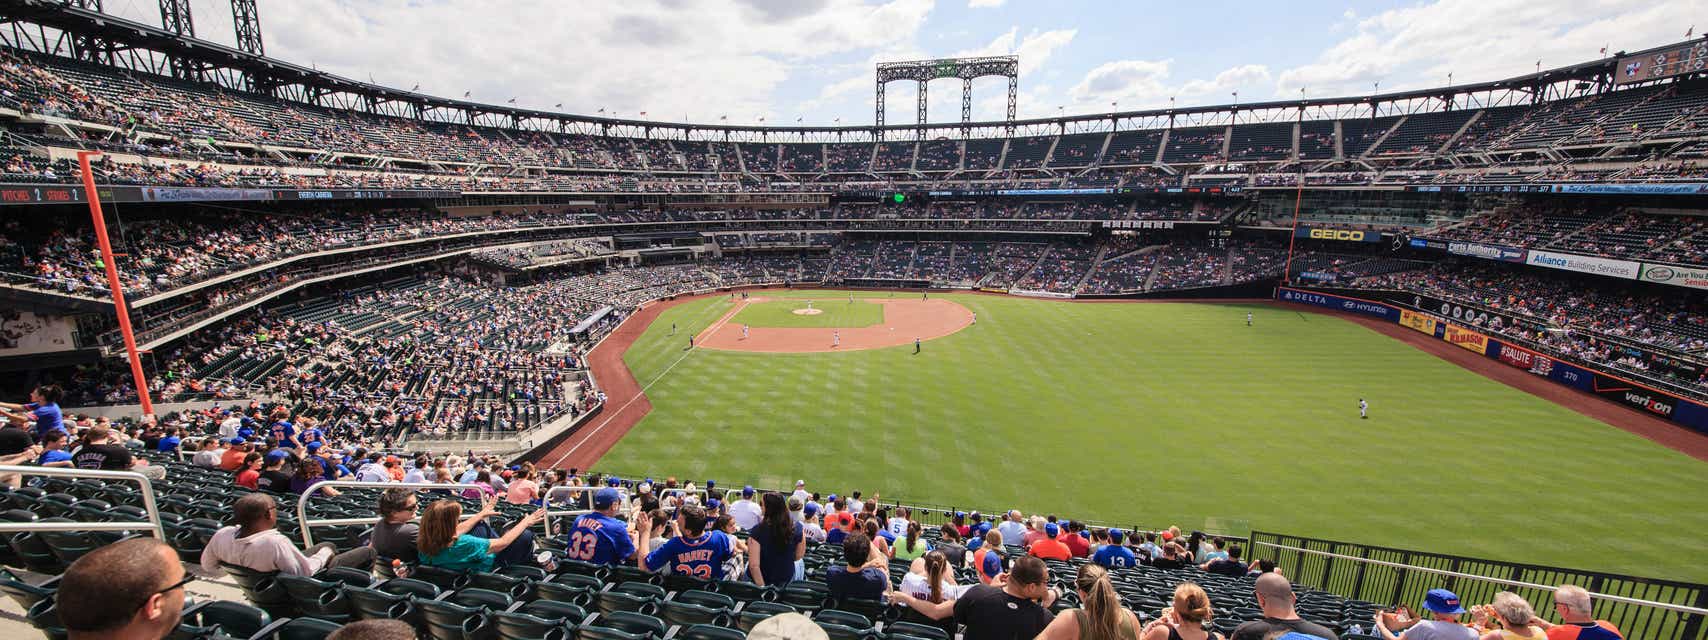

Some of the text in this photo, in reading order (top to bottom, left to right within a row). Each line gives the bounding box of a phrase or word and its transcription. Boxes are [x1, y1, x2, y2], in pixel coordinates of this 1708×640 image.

[1, 190, 30, 200] PITCHES
[34, 188, 41, 201] 2
[72, 188, 78, 200] 2
[1310, 228, 1364, 241] GEICO
[1467, 243, 1501, 256] Authority
[1533, 253, 1567, 267] Alliance
[1567, 260, 1597, 272] Building
[1597, 263, 1630, 276] Services
[1676, 271, 1689, 279] Are
[1689, 272, 1704, 280] You
[1294, 292, 1326, 304] DELTA
[1501, 345, 1531, 364] #SALUTE
[1564, 371, 1578, 381] 370
[1625, 392, 1672, 415] verizon
[893, 524, 901, 534] 5
[568, 531, 598, 560] 33
[678, 549, 714, 563] HARVEY
[1110, 555, 1126, 567] 13
